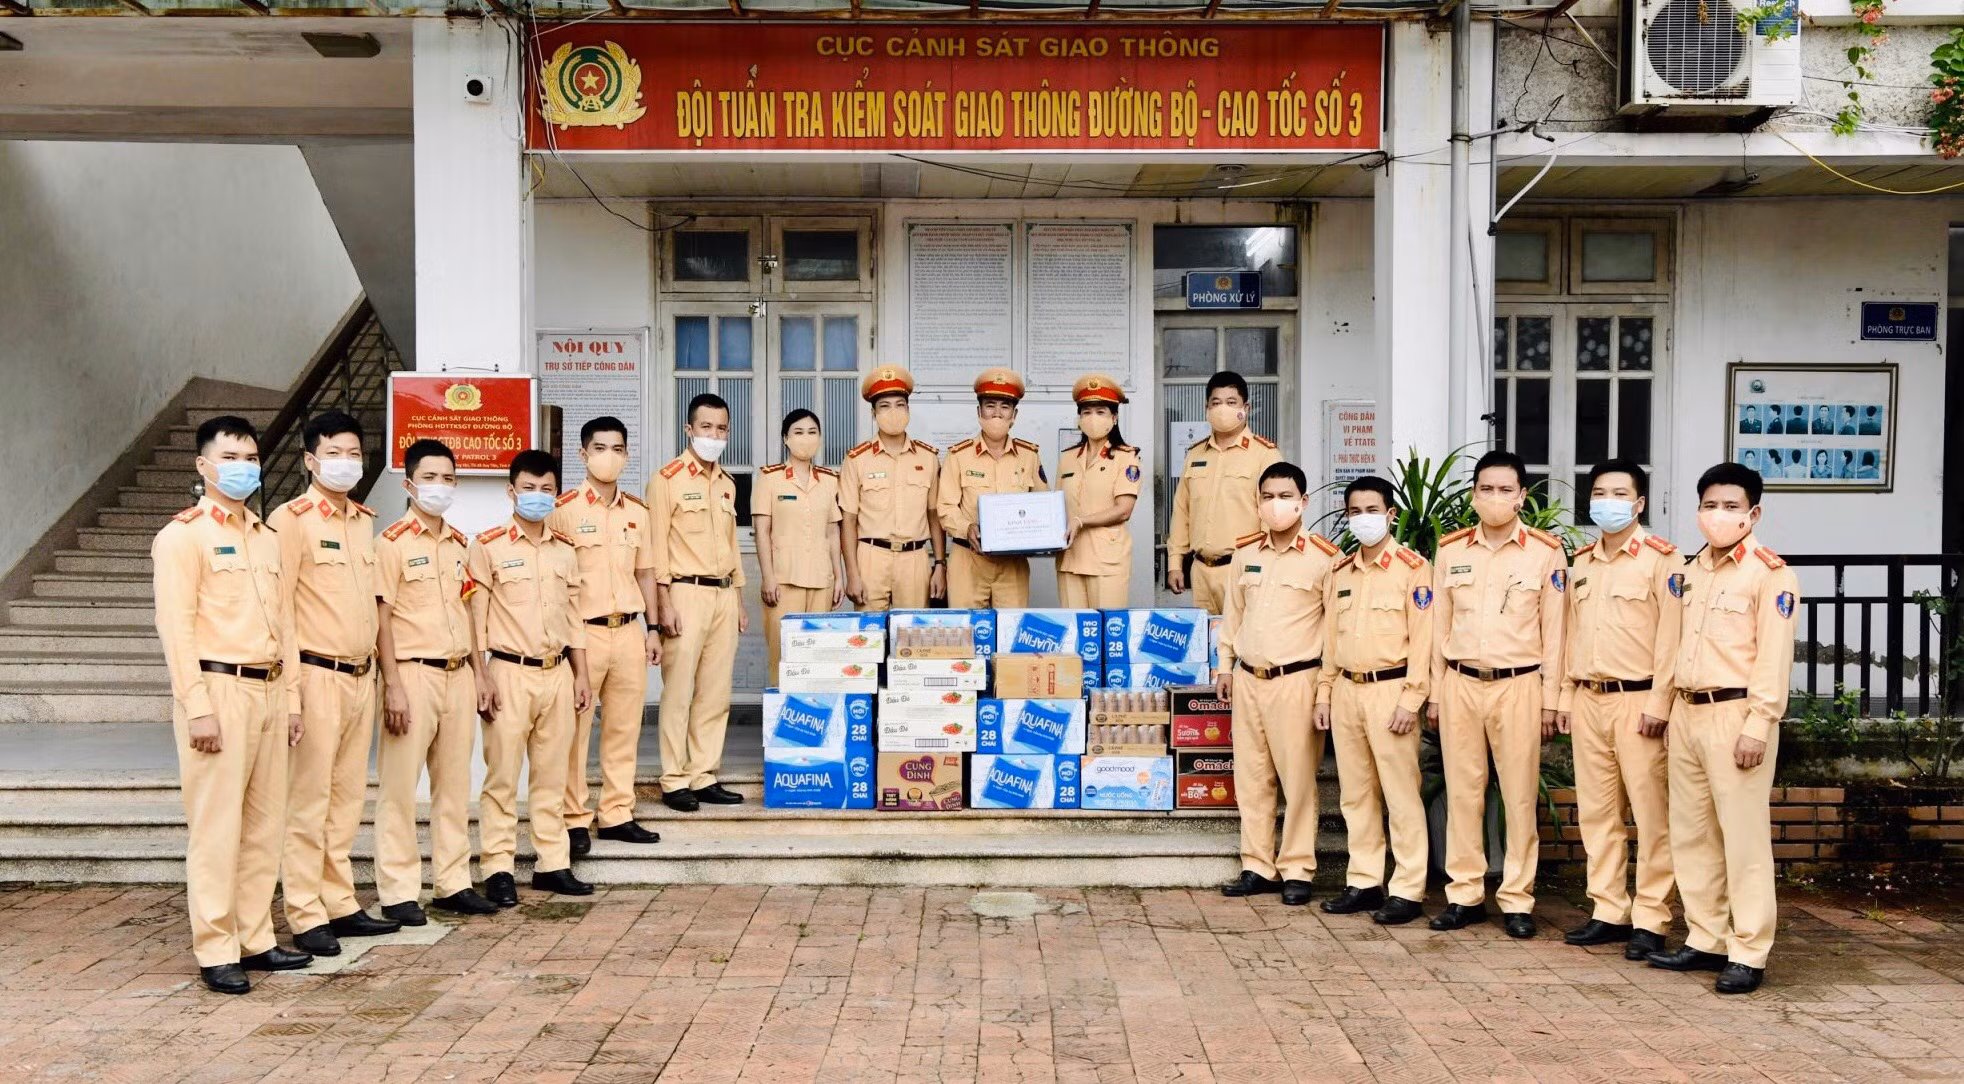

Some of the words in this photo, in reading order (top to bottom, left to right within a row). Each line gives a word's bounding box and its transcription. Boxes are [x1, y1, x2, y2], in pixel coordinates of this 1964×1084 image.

[817, 36, 873, 61] CỤC
[887, 27, 965, 58] CẢNH
[976, 31, 1029, 58] SÁT
[1040, 37, 1108, 58] GIAO
[1121, 31, 1219, 58] THÔNG
[677, 79, 713, 147] ĐỘI
[783, 91, 824, 138] TRA
[832, 67, 886, 138] KIỂM
[893, 81, 946, 138] SOÁT
[955, 91, 1004, 138] GIAO
[1011, 79, 1081, 138] THÔNG
[1088, 77, 1163, 138] ĐƯỜNG
[1171, 80, 1199, 147] BỘ
[1217, 91, 1259, 138] CAO
[1268, 71, 1307, 138] TỐC
[1315, 71, 1347, 138] SỐ
[1349, 92, 1363, 138] 3
[1192, 290, 1227, 303] PHÒNG
[1229, 289, 1244, 303] XỬ
[1246, 290, 1256, 303] LÝ
[1867, 324, 1894, 334] PHÒNG
[1895, 325, 1914, 336] TRỰC
[1916, 325, 1931, 335] BAN
[552, 338, 584, 357] NỘI
[588, 341, 627, 356] QUY
[544, 362, 560, 372] TRỤ
[562, 359, 573, 371] SỞ
[575, 360, 592, 372] TIẾP
[594, 360, 616, 372] CÔNG
[617, 360, 635, 372] DÂN
[1338, 411, 1359, 421] CÔNG
[1360, 411, 1375, 421] DÂN
[502, 422, 513, 431] BỘ
[1343, 425, 1350, 433] VI
[1351, 425, 1373, 436] PHẠM
[463, 436, 482, 450] CAO
[483, 432, 500, 450] TỐC
[502, 432, 515, 450] SỐ
[516, 437, 522, 450] 3
[1083, 627, 1098, 637] 28
[1144, 621, 1188, 649] AQUAFINA
[976, 644, 991, 655] 28
[1109, 641, 1123, 651] 28
[1188, 699, 1232, 710] Omach
[780, 705, 826, 735] AQUAFINA
[1020, 710, 1064, 740] AQUAFINA
[851, 724, 867, 735] 28
[981, 730, 996, 740] 28
[905, 762, 932, 770] CUNG
[1193, 760, 1234, 771] Omach
[773, 772, 834, 789] AQUAFINA
[989, 767, 1034, 797] AQUAFINA
[852, 781, 868, 792] 28
[1060, 786, 1075, 797] 28
